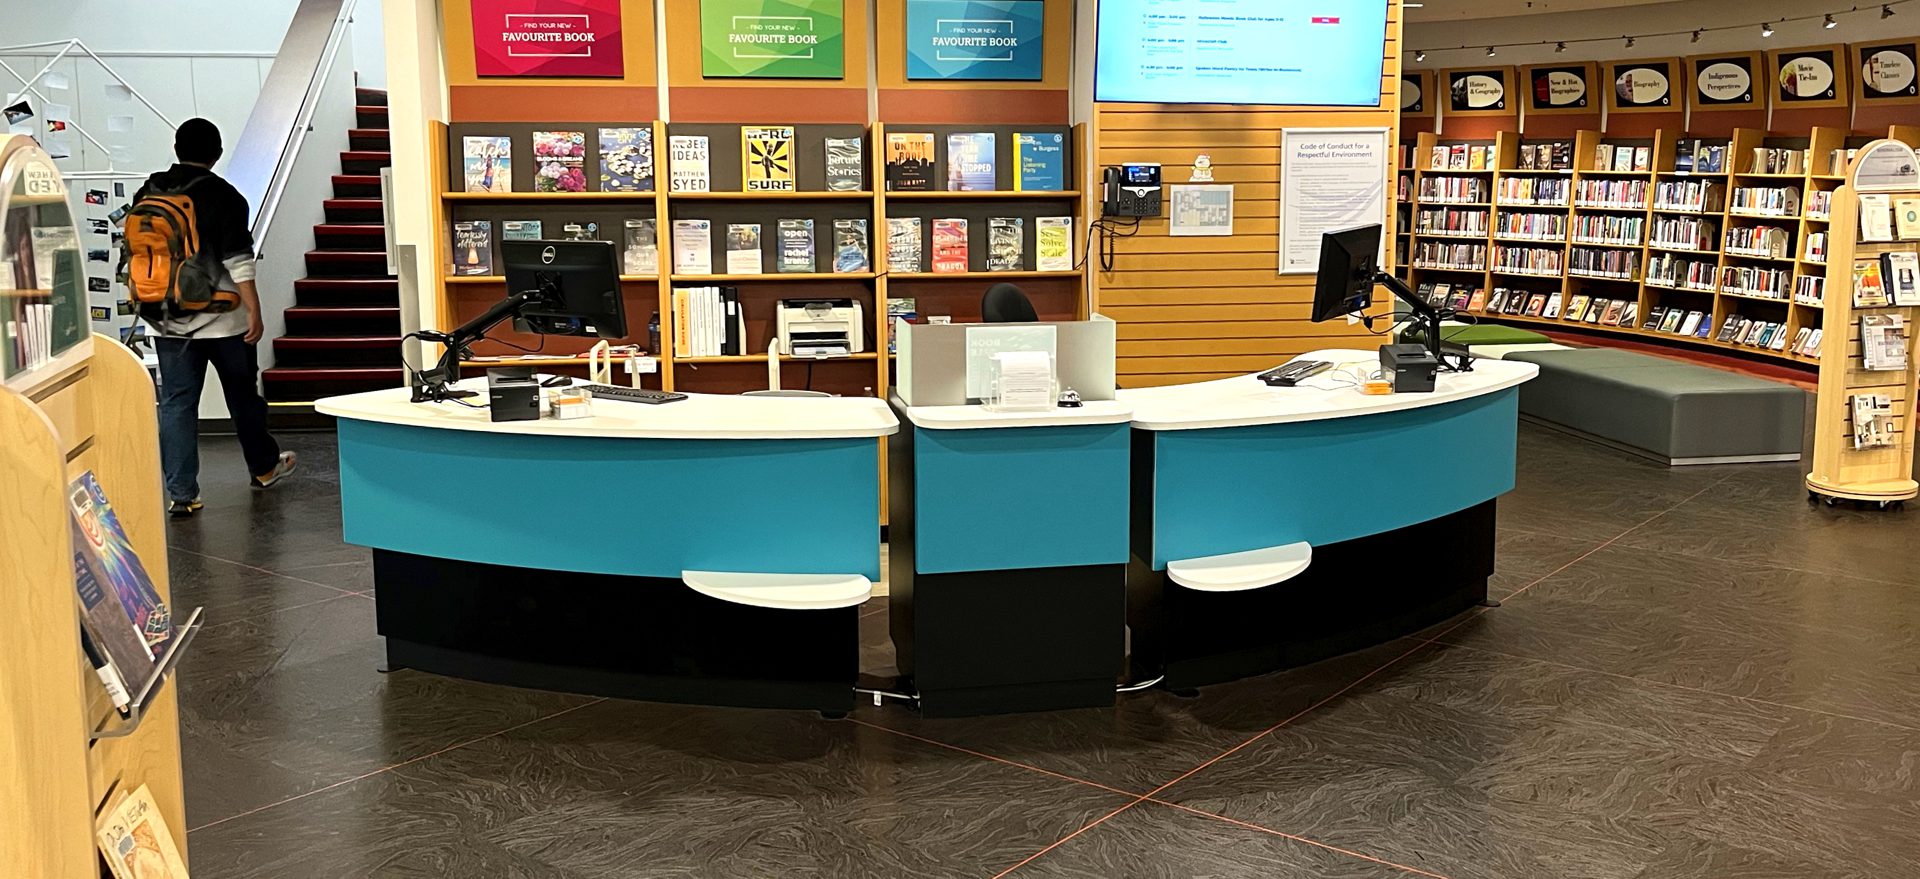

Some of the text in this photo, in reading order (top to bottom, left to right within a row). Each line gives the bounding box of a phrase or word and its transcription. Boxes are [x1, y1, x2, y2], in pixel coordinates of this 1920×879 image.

[502, 32, 595, 42] FAVOURITE BOOK
[729, 34, 818, 44] FAVOURITE BOOK
[932, 37, 1017, 47] FAVOURITE BOOK
[1798, 64, 1813, 72] Movie
[1634, 80, 1660, 88] Biography
[672, 151, 706, 160] IDEAS
[828, 154, 861, 165] Future
[1297, 151, 1331, 159] Respectful
[828, 166, 861, 176] Stories
[673, 179, 706, 190] SYED
[749, 180, 792, 190] SURF
[784, 230, 808, 238] open
